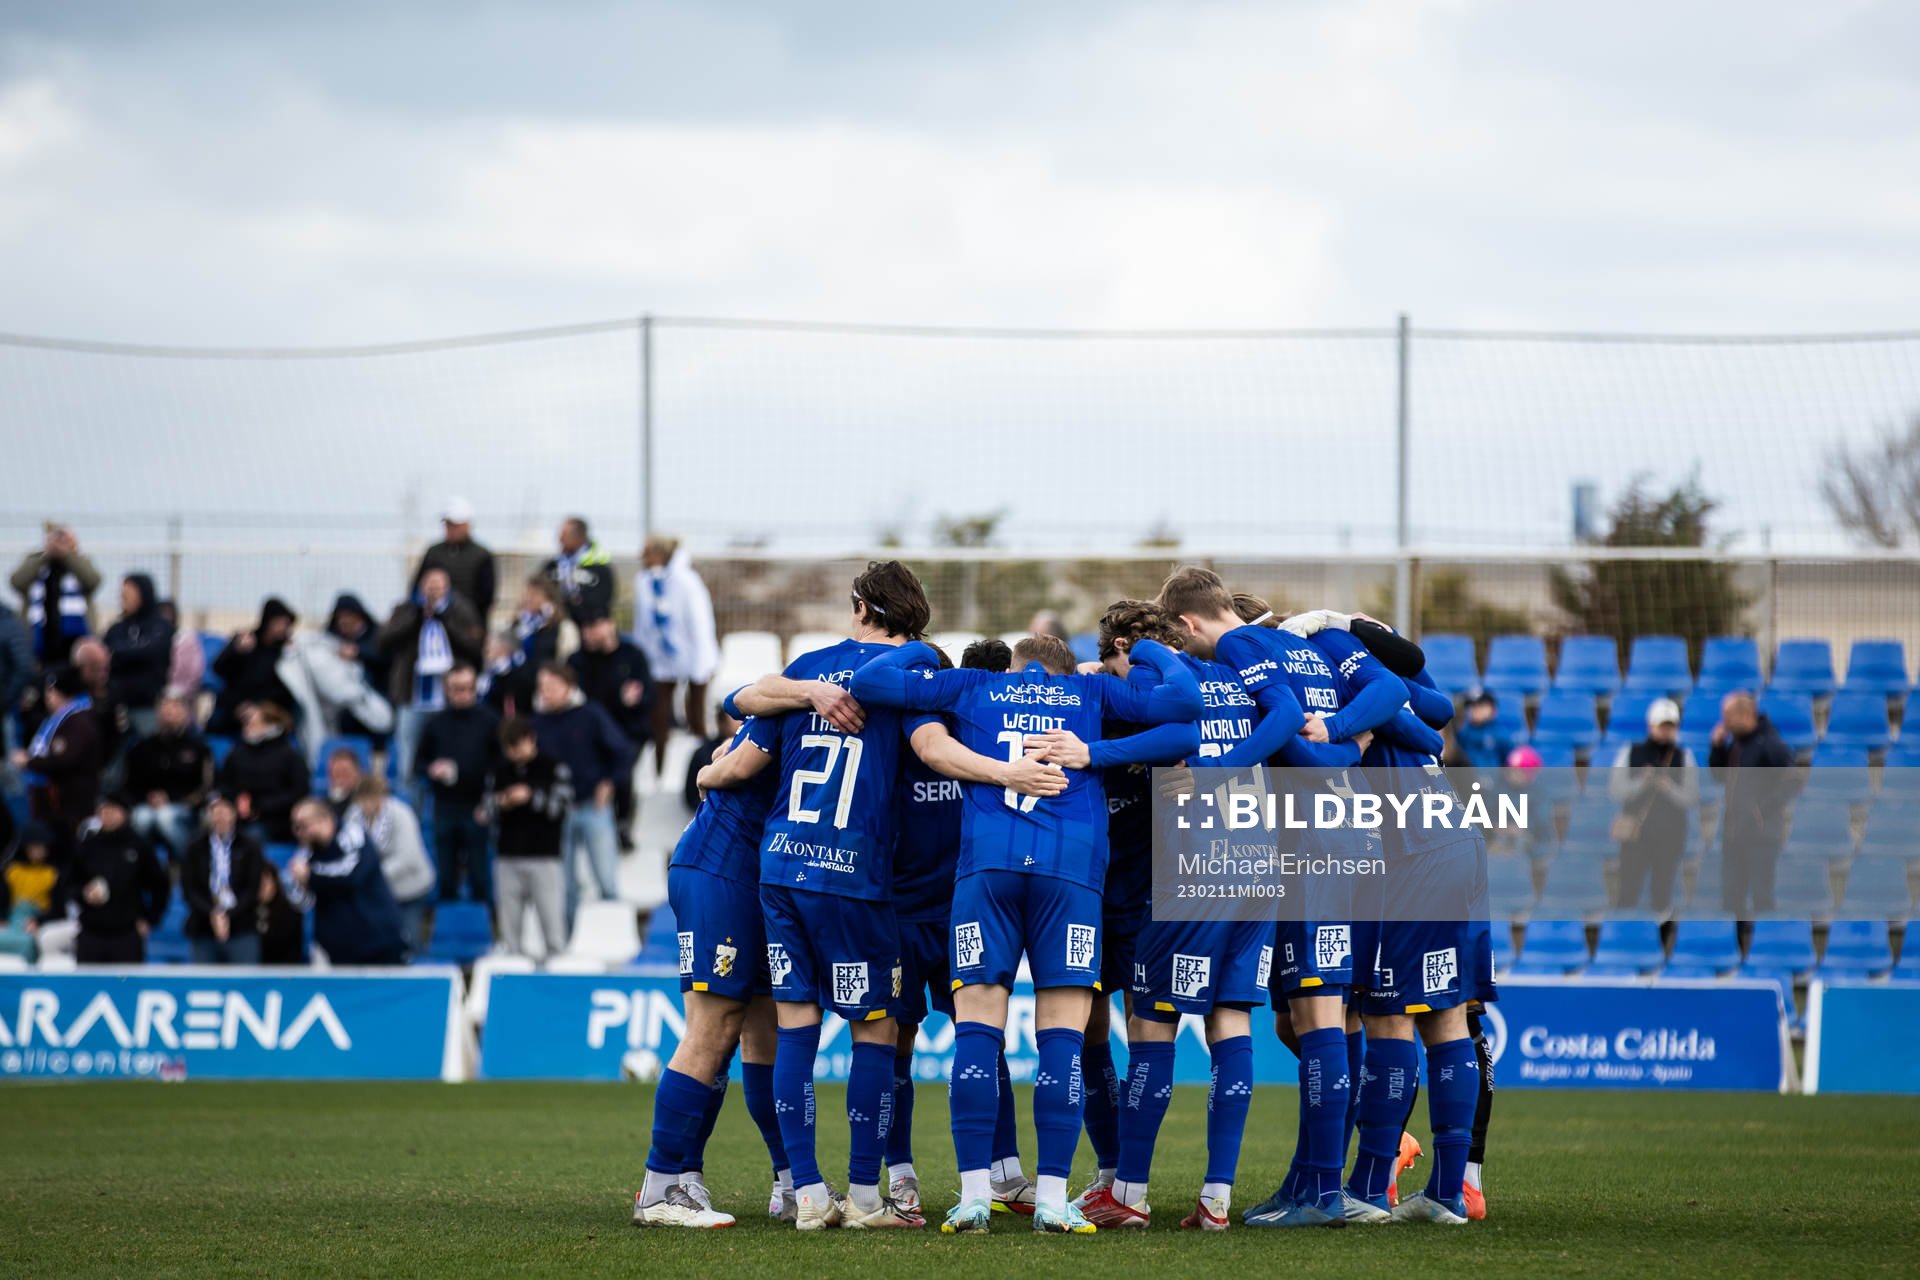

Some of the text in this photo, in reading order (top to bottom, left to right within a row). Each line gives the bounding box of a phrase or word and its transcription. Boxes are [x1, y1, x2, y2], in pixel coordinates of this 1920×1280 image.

[989, 691, 1082, 707] WELLNESS
[1003, 713, 1067, 732] WENDT
[1200, 718, 1252, 741] NORLIN
[787, 734, 864, 831] 21
[957, 925, 976, 940] EFF
[1070, 927, 1092, 941] EFF
[1319, 928, 1344, 941] EFF
[958, 937, 981, 953] EKT
[1070, 939, 1094, 954] EKT
[1285, 942, 1295, 963] 8
[1318, 940, 1348, 952] EKT
[958, 951, 972, 964] IV
[1069, 951, 1085, 964] IV
[1176, 957, 1204, 971] EFF
[1319, 952, 1333, 965] IV
[1426, 952, 1450, 967] EFF
[835, 965, 862, 978] EFF
[1134, 962, 1147, 984] 14
[1175, 968, 1207, 983] EKT
[1382, 968, 1394, 987] 3
[1426, 962, 1454, 978] EKT
[835, 977, 866, 990] EKT
[1174, 981, 1191, 993] IV
[1426, 977, 1442, 989] IV
[836, 989, 854, 1002] IV
[1520, 1025, 1717, 1061] Costa Cálida
[1067, 1053, 1082, 1107] SILFVERLOK
[1127, 1062, 1150, 1112] SILFVERLOK
[1308, 1058, 1322, 1108] SILFVERLOK
[1387, 1066, 1405, 1101] FVERLOK
[803, 1081, 815, 1127] SILFVERLOK
[876, 1092, 892, 1140] SILFVERLOK
